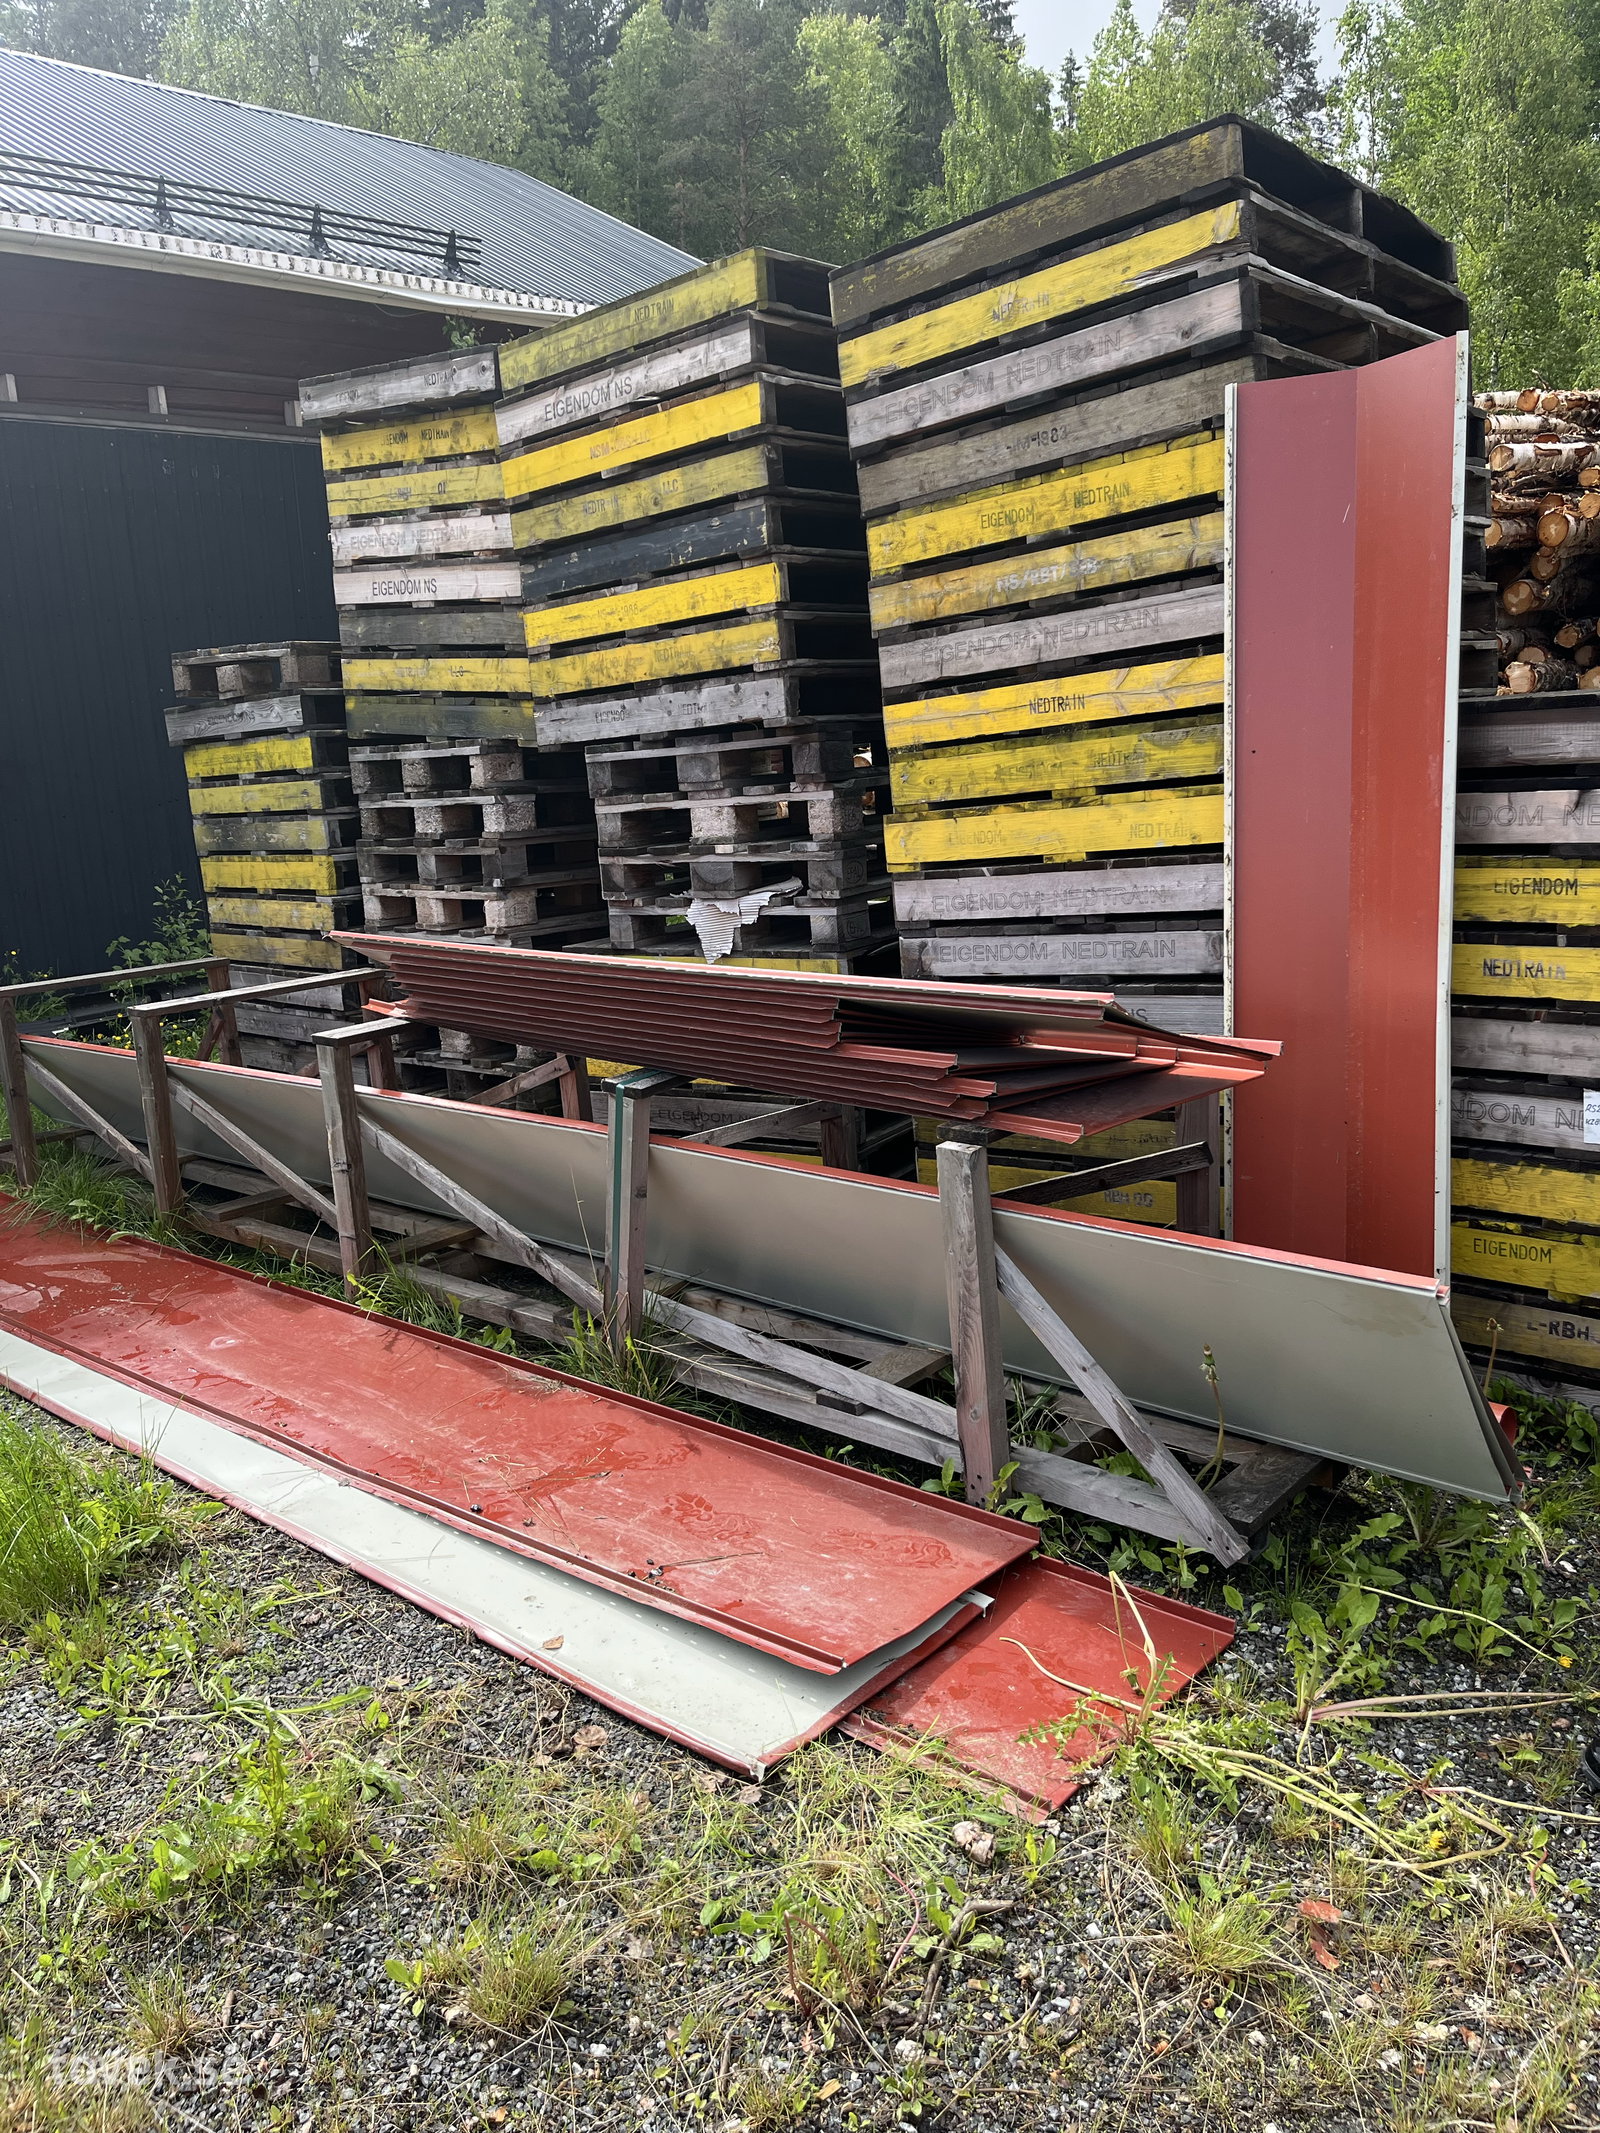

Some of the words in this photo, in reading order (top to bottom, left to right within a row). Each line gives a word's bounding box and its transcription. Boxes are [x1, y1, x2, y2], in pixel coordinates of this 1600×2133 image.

[885, 371, 994, 424] EIGENDOM
[1006, 330, 1121, 386] NEDTRAIN
[544, 387, 611, 422] EIGENDOM
[614, 376, 633, 395] NS
[981, 505, 1036, 530] EIGENDOM
[1073, 482, 1130, 509] NEDTRAIN
[372, 581, 421, 596] EIGENDOM
[424, 578, 437, 594] NS
[921, 630, 1031, 666] EIGENDOM
[1043, 607, 1159, 648] NEDTRAIN
[1029, 694, 1085, 714] NEDTRAIN
[932, 890, 1041, 913] EIGENDOM
[1053, 884, 1167, 907] NEDTRAIN
[1494, 877, 1578, 896] EIGENDOM
[939, 941, 1048, 963] EIGENDOM
[1061, 938, 1176, 960] NEDTRAIN
[1482, 958, 1567, 980] NEDTRAIN
[1473, 1237, 1552, 1264] EIGENDOM
